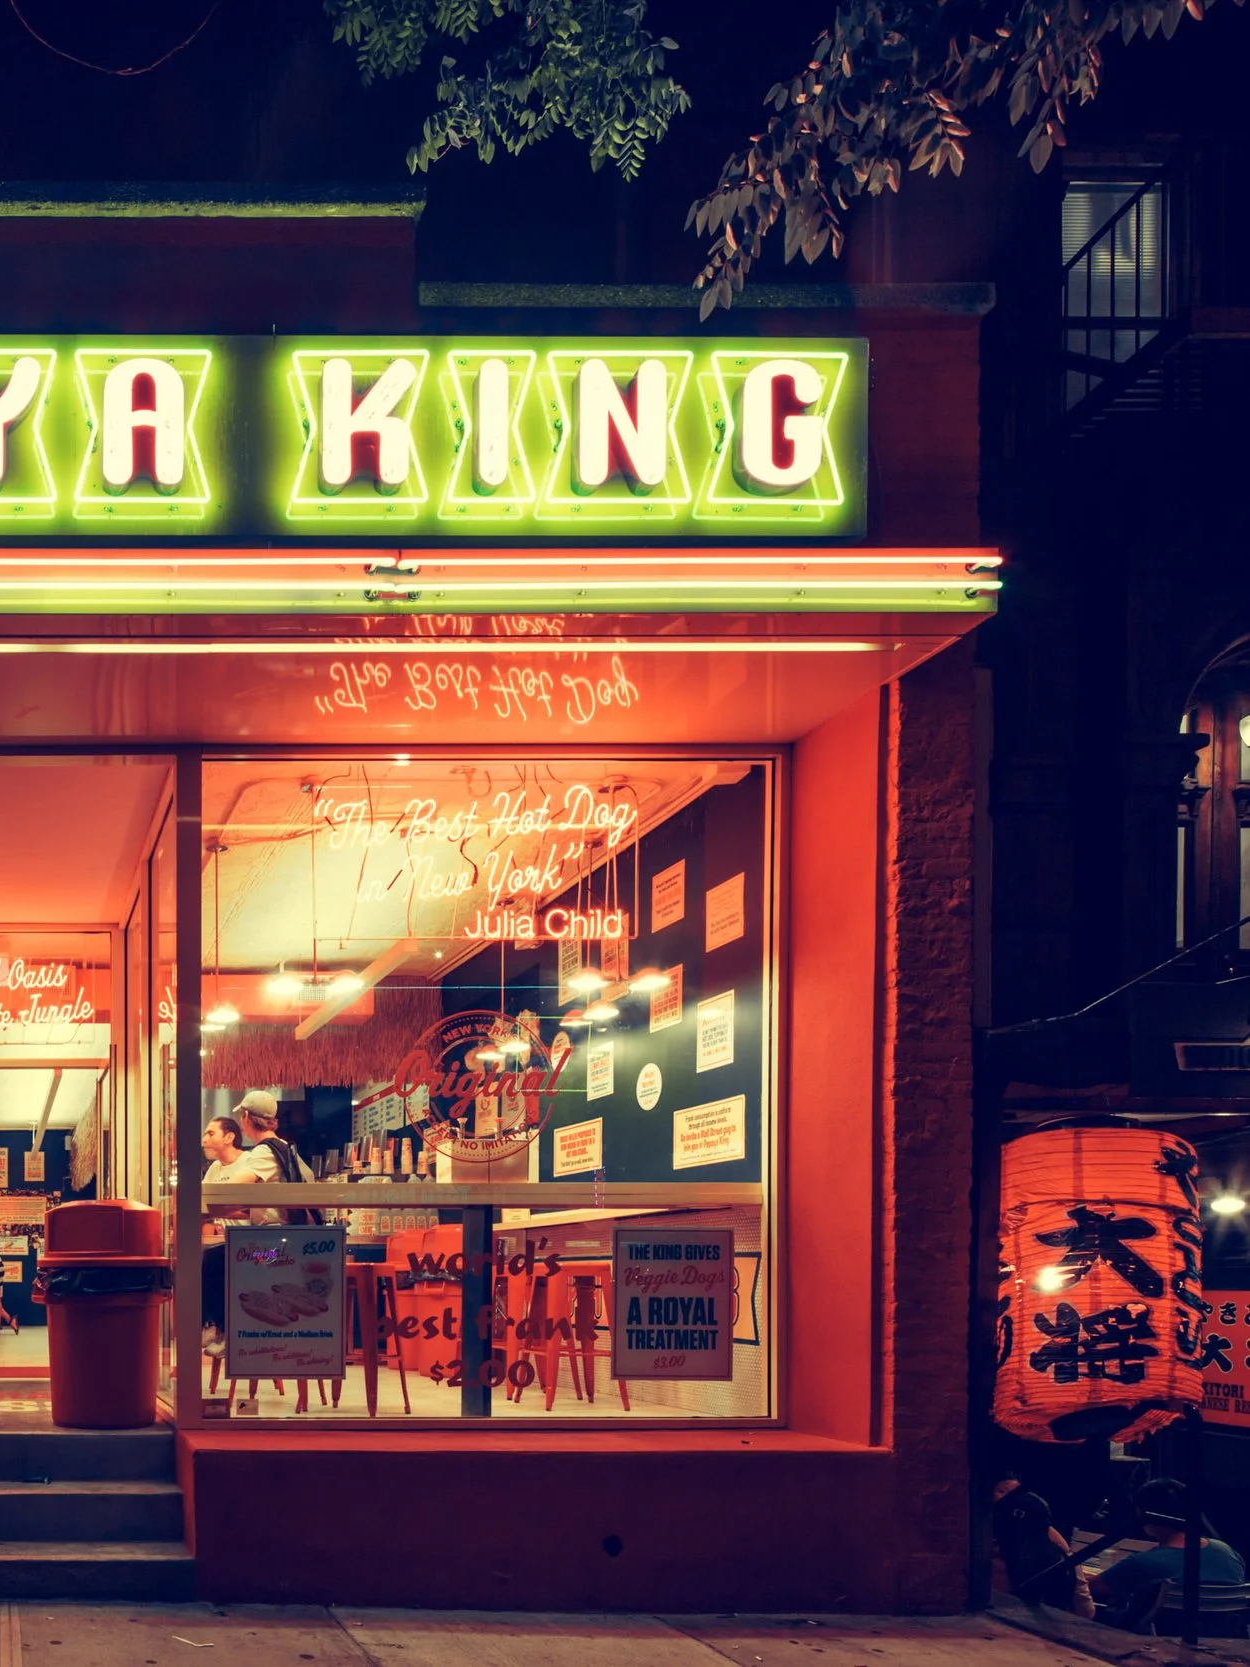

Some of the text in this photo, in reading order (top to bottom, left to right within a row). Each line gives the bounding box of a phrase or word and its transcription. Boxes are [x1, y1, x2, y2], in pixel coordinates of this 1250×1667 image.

[318, 357, 825, 495] KING
[403, 797, 479, 844] Best
[487, 789, 552, 840] Hot
[558, 784, 638, 848] Dog
[401, 854, 473, 903] New
[463, 908, 624, 940] Julia Child
[7, 958, 68, 988] Oasis
[18, 985, 95, 1025] Jungle
[442, 1024, 472, 1043] NEW
[393, 1044, 575, 1119] Original
[460, 1140, 479, 1151] NO
[302, 1240, 336, 1256] $5.00
[406, 1236, 563, 1277] world's
[627, 1243, 720, 1261] THE KING GIVES
[624, 1264, 725, 1294] Veggie Dogs
[474, 1304, 599, 1342] frank
[627, 1296, 642, 1326] A
[648, 1296, 718, 1326] ROYAL
[625, 1328, 719, 1350] TREATMENT
[653, 1355, 686, 1369] $3.00
[1202, 1383, 1245, 1399] KITORI
